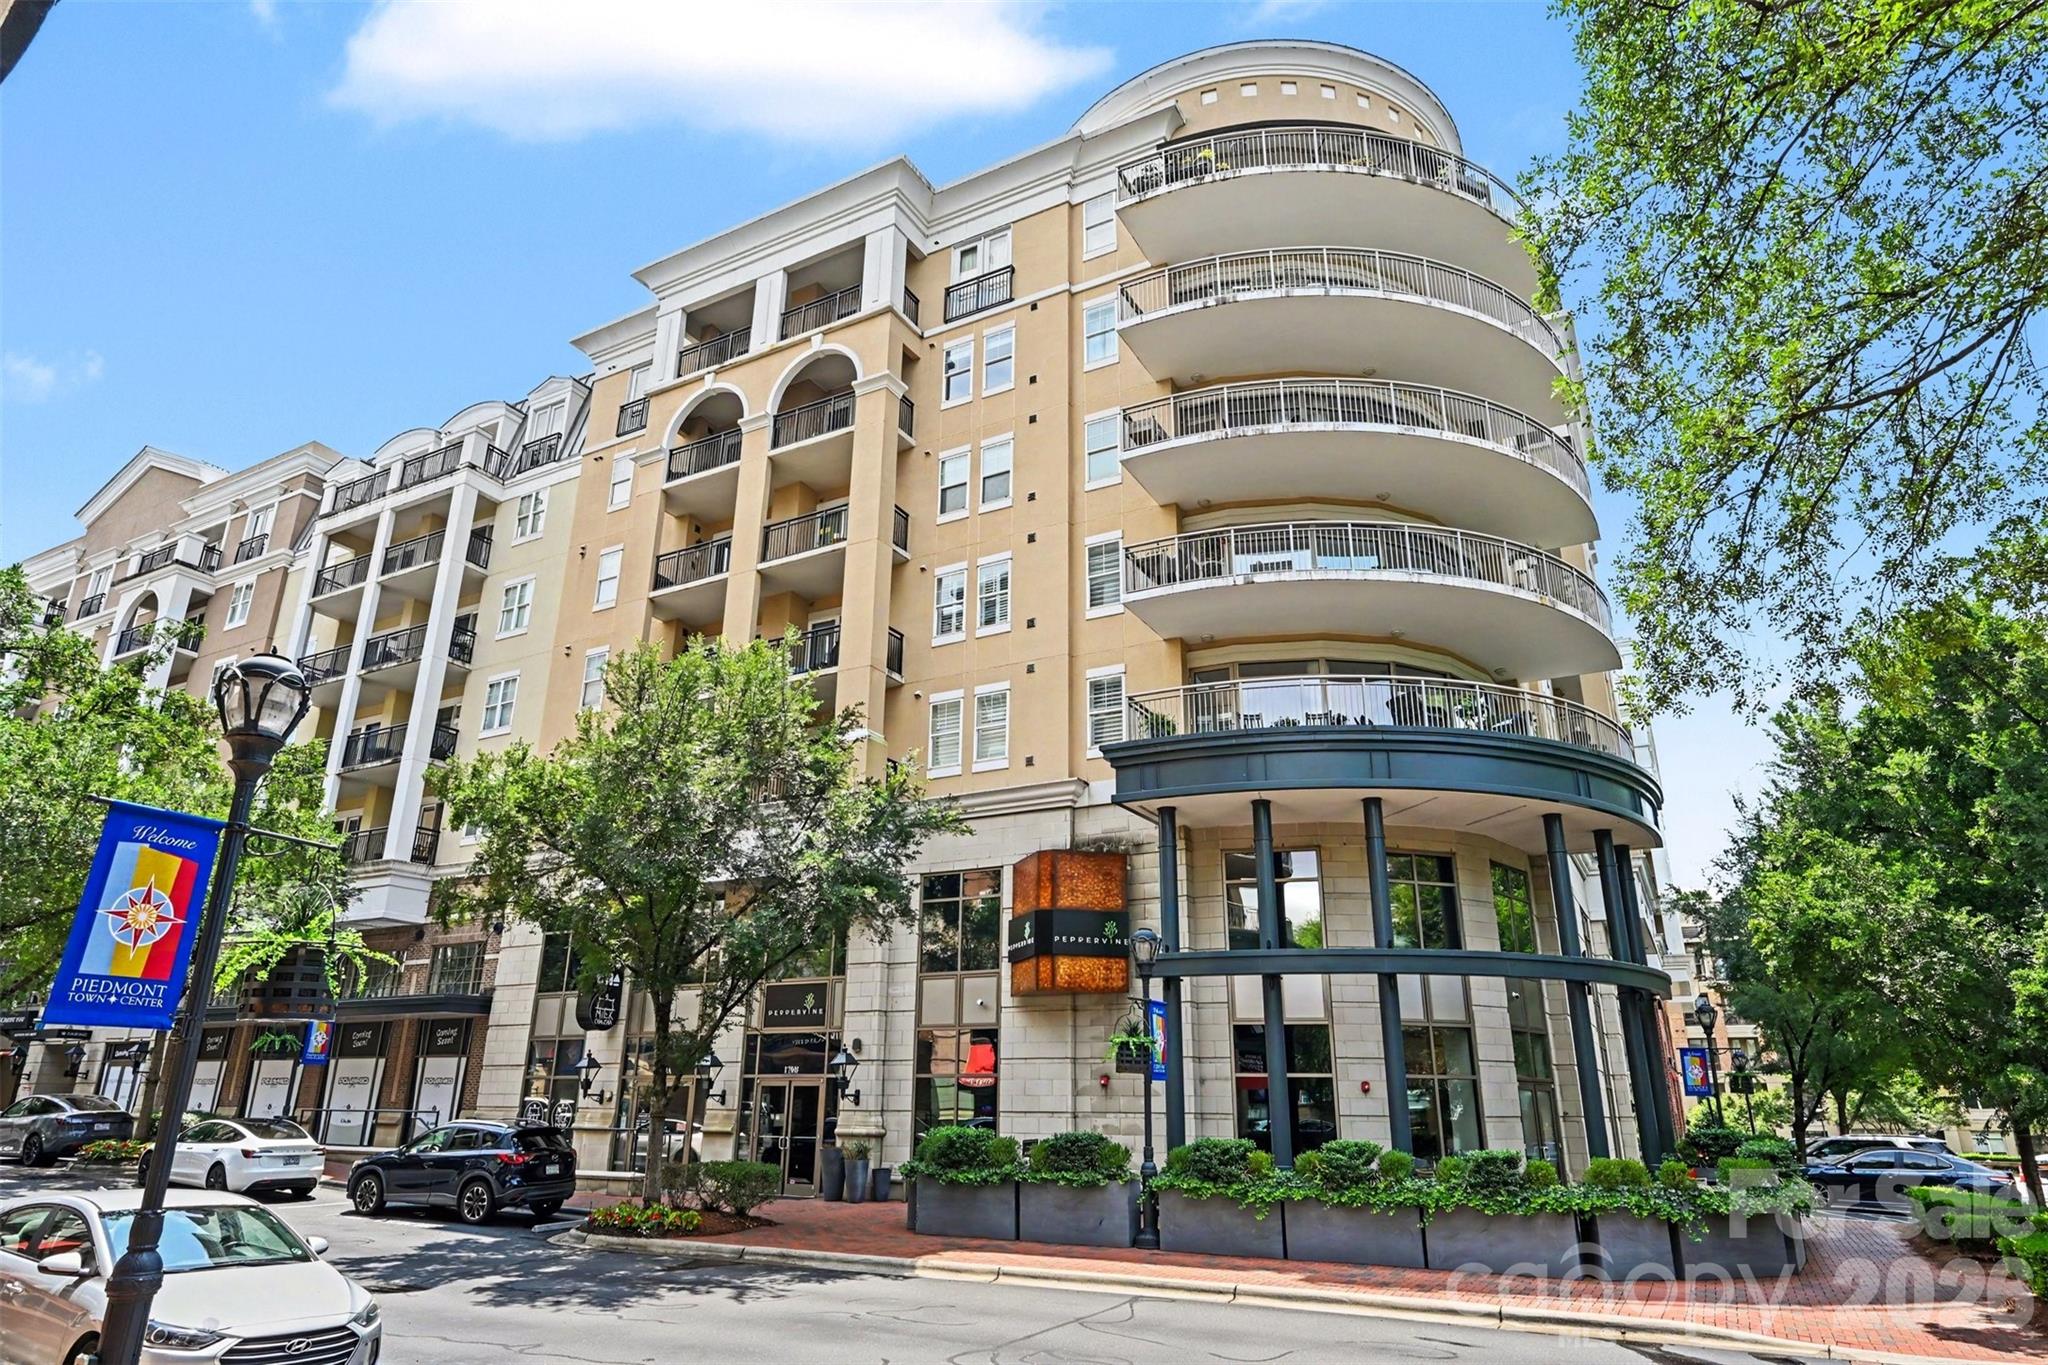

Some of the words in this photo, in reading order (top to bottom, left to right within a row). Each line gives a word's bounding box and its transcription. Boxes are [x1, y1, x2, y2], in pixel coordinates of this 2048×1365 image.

[132, 825, 197, 850] Welcome
[1054, 935, 1129, 945] PEPPERVINE
[71, 977, 168, 998] PIEDMONT
[67, 992, 107, 1003] TOWN
[120, 996, 163, 1008] CENTER
[768, 1008, 824, 1016] PEPPERVINE
[436, 1028, 458, 1037] Coming
